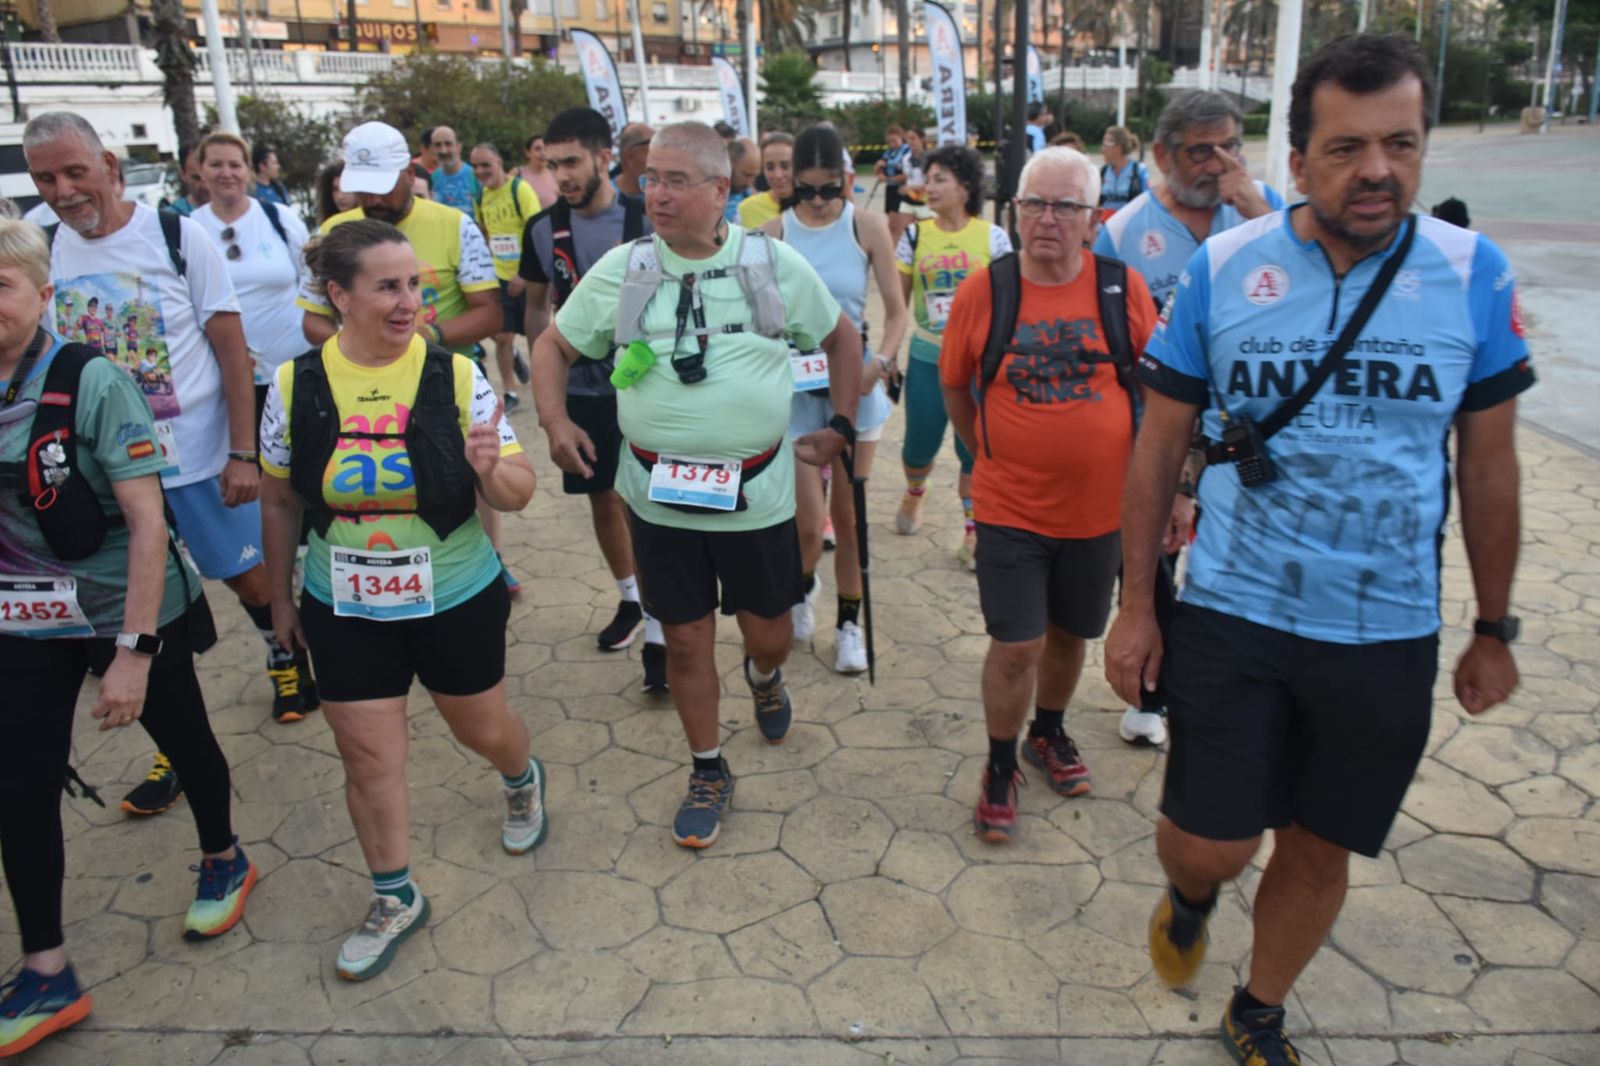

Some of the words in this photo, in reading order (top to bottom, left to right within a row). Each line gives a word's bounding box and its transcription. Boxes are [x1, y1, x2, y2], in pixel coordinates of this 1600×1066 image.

[1239, 336, 1284, 354] club
[1291, 336, 1318, 353] de
[1321, 338, 1425, 357] ntaña
[802, 359, 826, 374] 13
[1287, 402, 1377, 430] EUTA
[337, 402, 411, 453] ad
[333, 452, 417, 496] as
[668, 463, 731, 485] 1379
[347, 573, 422, 596] 1344
[1, 601, 73, 621] 1352
